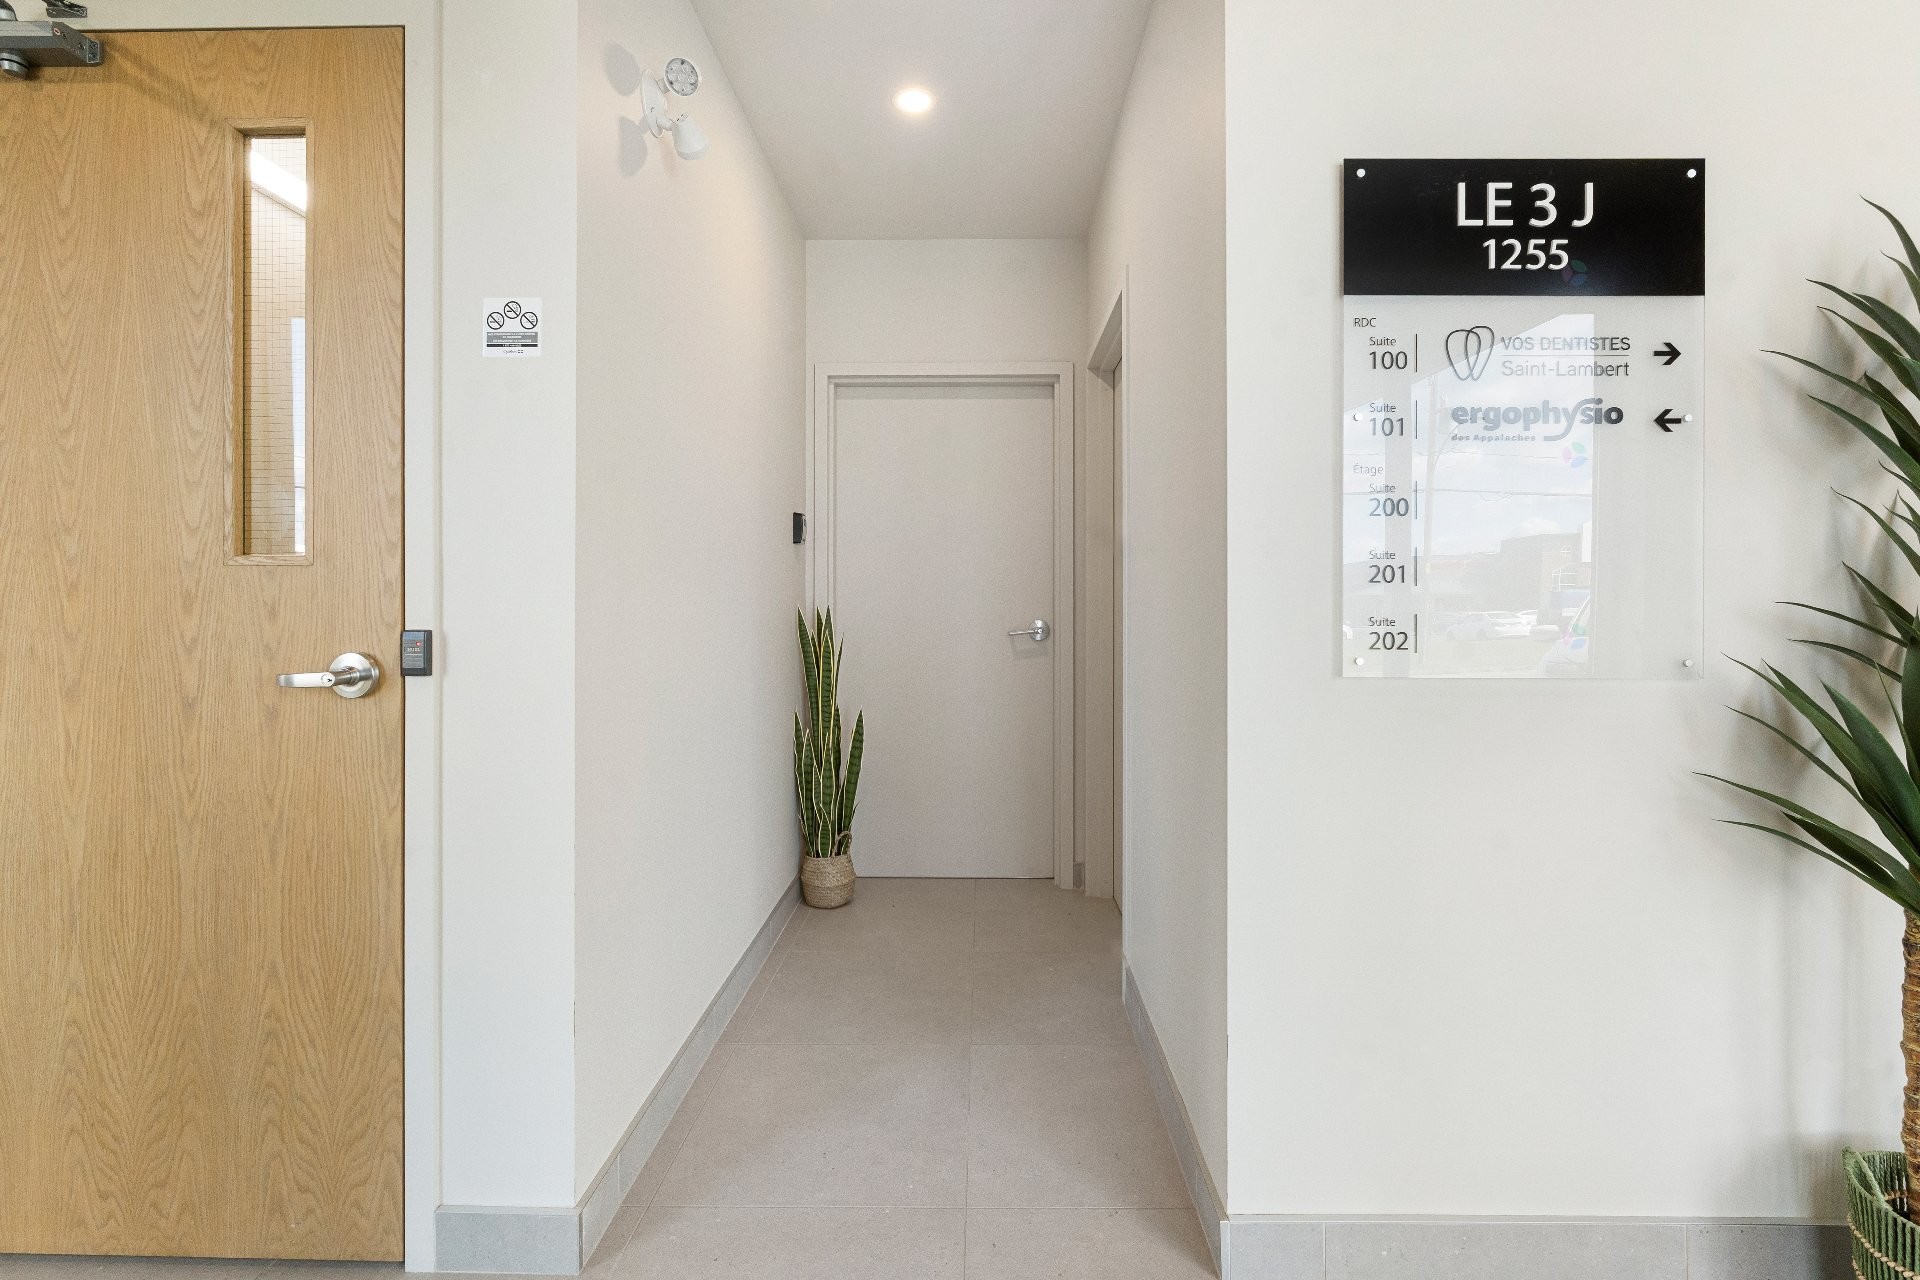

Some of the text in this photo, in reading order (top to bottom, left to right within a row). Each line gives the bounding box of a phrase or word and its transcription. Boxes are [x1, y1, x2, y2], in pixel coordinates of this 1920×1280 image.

[1456, 182, 1594, 228] LE 3 J
[1483, 239, 1569, 270] 1255
[1353, 317, 1377, 328] RDC
[1369, 336, 1397, 346] Suite
[1501, 336, 1631, 351] VOS DENTISTES
[1369, 351, 1408, 370] 100
[1502, 360, 1630, 377] Saint-Lambert
[1369, 403, 1397, 413] Suite
[1370, 417, 1405, 437] 101
[1451, 397, 1624, 441] ergophysio
[1451, 433, 1536, 443] des Appalaches
[1353, 462, 1384, 476] Étage
[1369, 483, 1396, 493] Suite
[1369, 498, 1410, 517] 200
[1369, 550, 1396, 560] Suite
[1368, 565, 1406, 584] 201
[1369, 616, 1396, 627] Suite
[1369, 631, 1409, 651] 202
